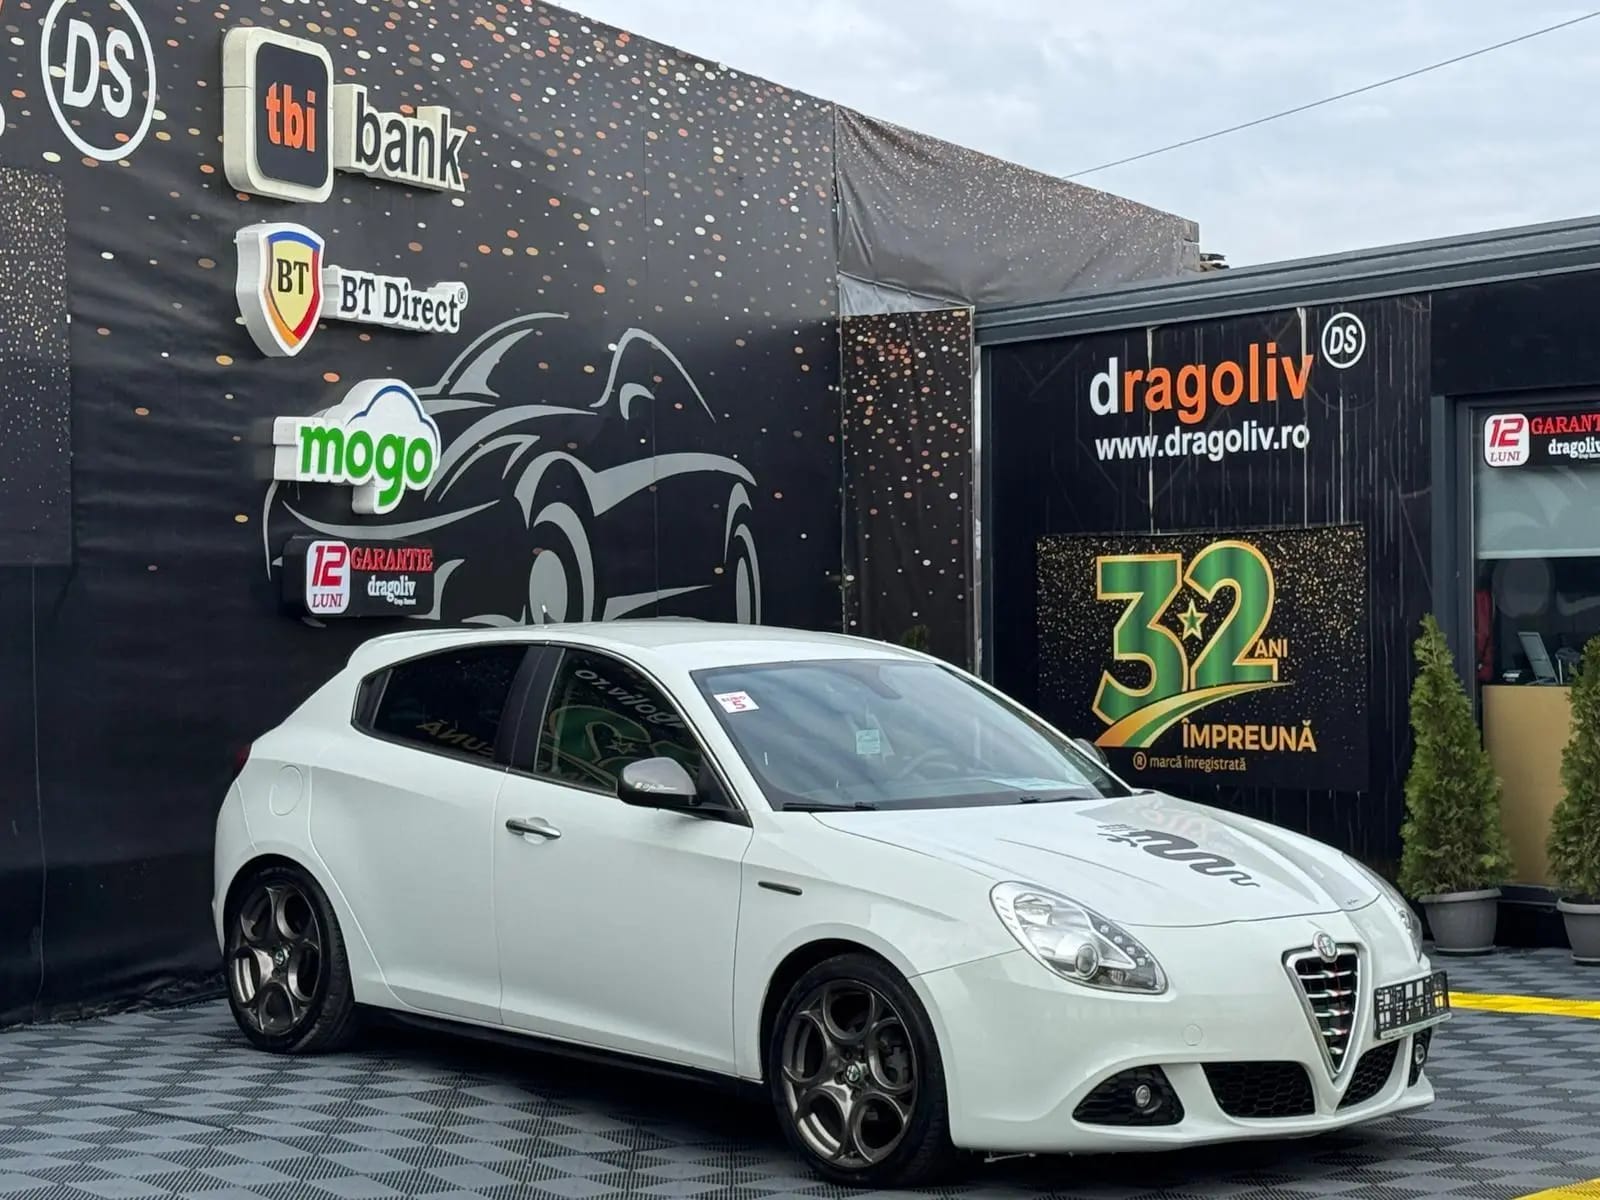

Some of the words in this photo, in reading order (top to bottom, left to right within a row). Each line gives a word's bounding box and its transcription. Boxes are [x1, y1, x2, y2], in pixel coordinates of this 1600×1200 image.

[63, 18, 134, 119] DS
[266, 81, 316, 152] tbi
[356, 91, 463, 185] bank
[276, 258, 309, 296] BT
[340, 275, 376, 315] BT
[1329, 324, 1358, 355] DS
[1089, 341, 1314, 424] dragoliv
[1095, 420, 1311, 462] www.dragoliv.ro
[1489, 417, 1525, 448] 12
[301, 426, 433, 507] mogo
[1490, 451, 1521, 463] LUNI
[312, 545, 347, 587] 12
[351, 547, 434, 571] GARANTIE
[311, 593, 343, 609] LUNI
[367, 574, 417, 603] dragoliv
[1091, 539, 1278, 728] 32
[1253, 638, 1288, 658] ANI
[1182, 718, 1317, 753] ÎMPREUNĂ
